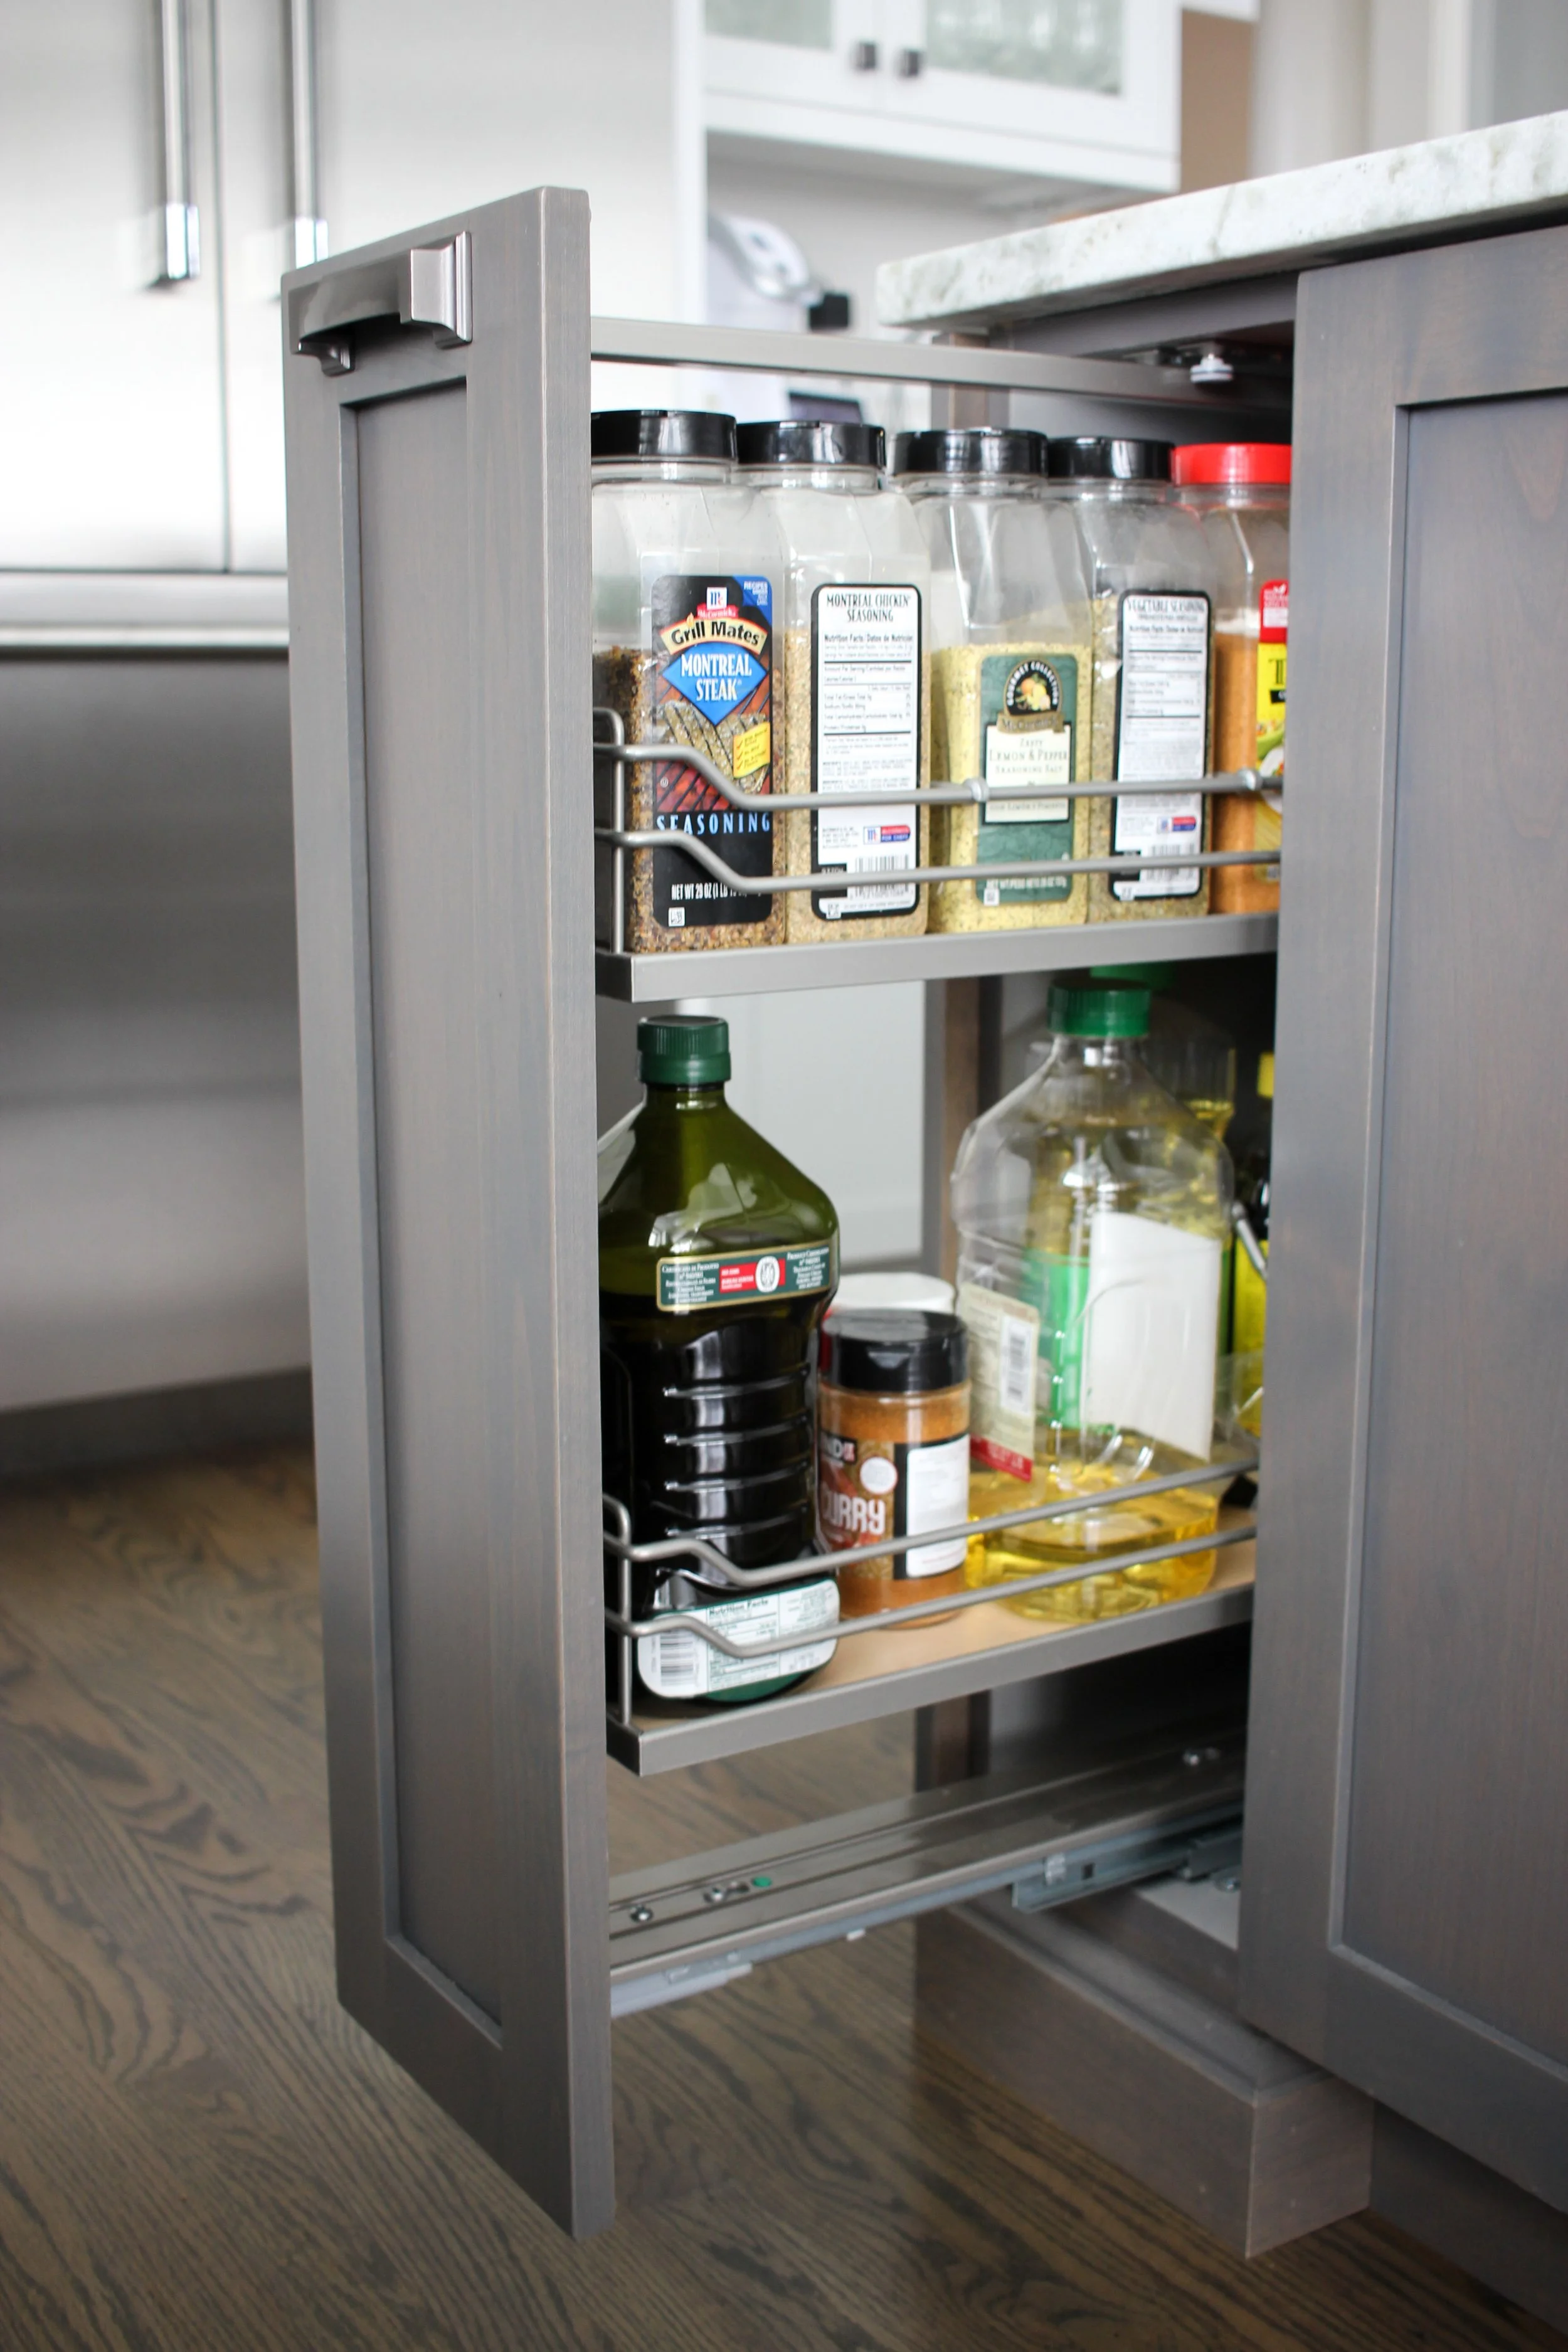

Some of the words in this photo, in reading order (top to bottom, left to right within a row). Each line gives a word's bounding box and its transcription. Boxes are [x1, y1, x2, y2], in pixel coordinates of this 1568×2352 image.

[827, 593, 873, 607] MONTREAL
[875, 592, 909, 608] CHICKEN
[847, 608, 894, 622] SEASONING
[670, 621, 706, 645] Grill
[711, 621, 760, 646] Mates
[824, 633, 847, 642] Nutrition
[681, 653, 752, 677] MONTREAL
[696, 678, 738, 701] STEAK
[656, 813, 770, 835] SEASONING
[671, 884, 684, 901] NET
[684, 882, 695, 899] WT
[696, 882, 703, 899] 29
[704, 882, 712, 899] OZ
[709, 1601, 745, 1617] Nutrition
[746, 1597, 769, 1609] Facts
